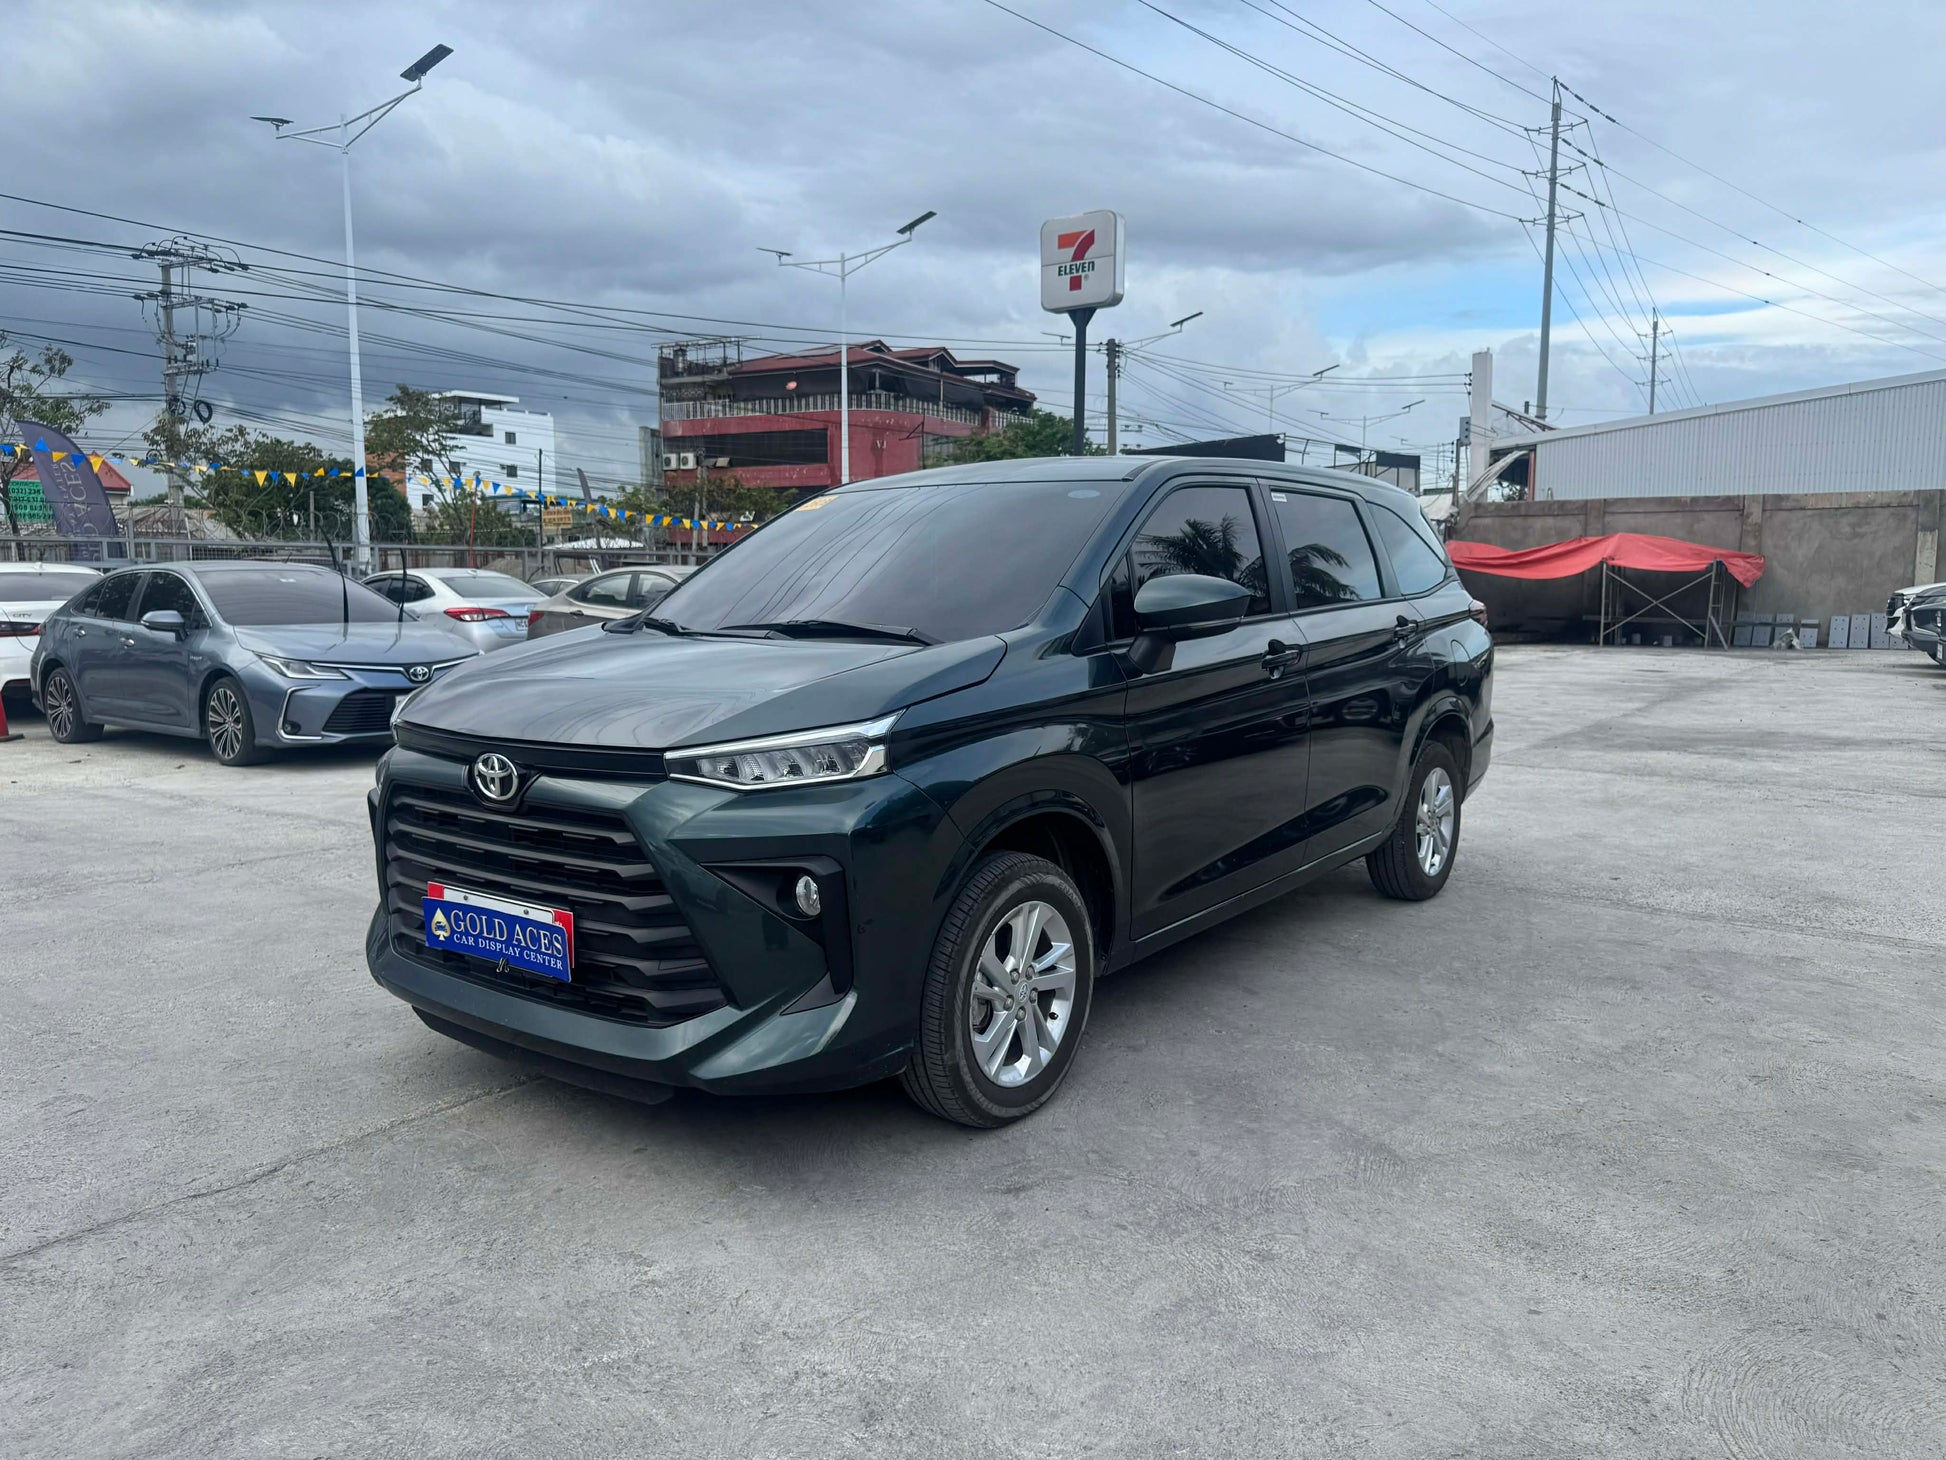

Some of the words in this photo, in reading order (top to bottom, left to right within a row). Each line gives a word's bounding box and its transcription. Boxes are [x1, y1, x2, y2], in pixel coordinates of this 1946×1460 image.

[1058, 229, 1095, 291] 7
[451, 909, 508, 941] GOLD
[513, 923, 564, 957] ACES
[454, 934, 475, 946] CAR
[479, 938, 521, 957] DISPLAY
[524, 950, 563, 970] CENTER
